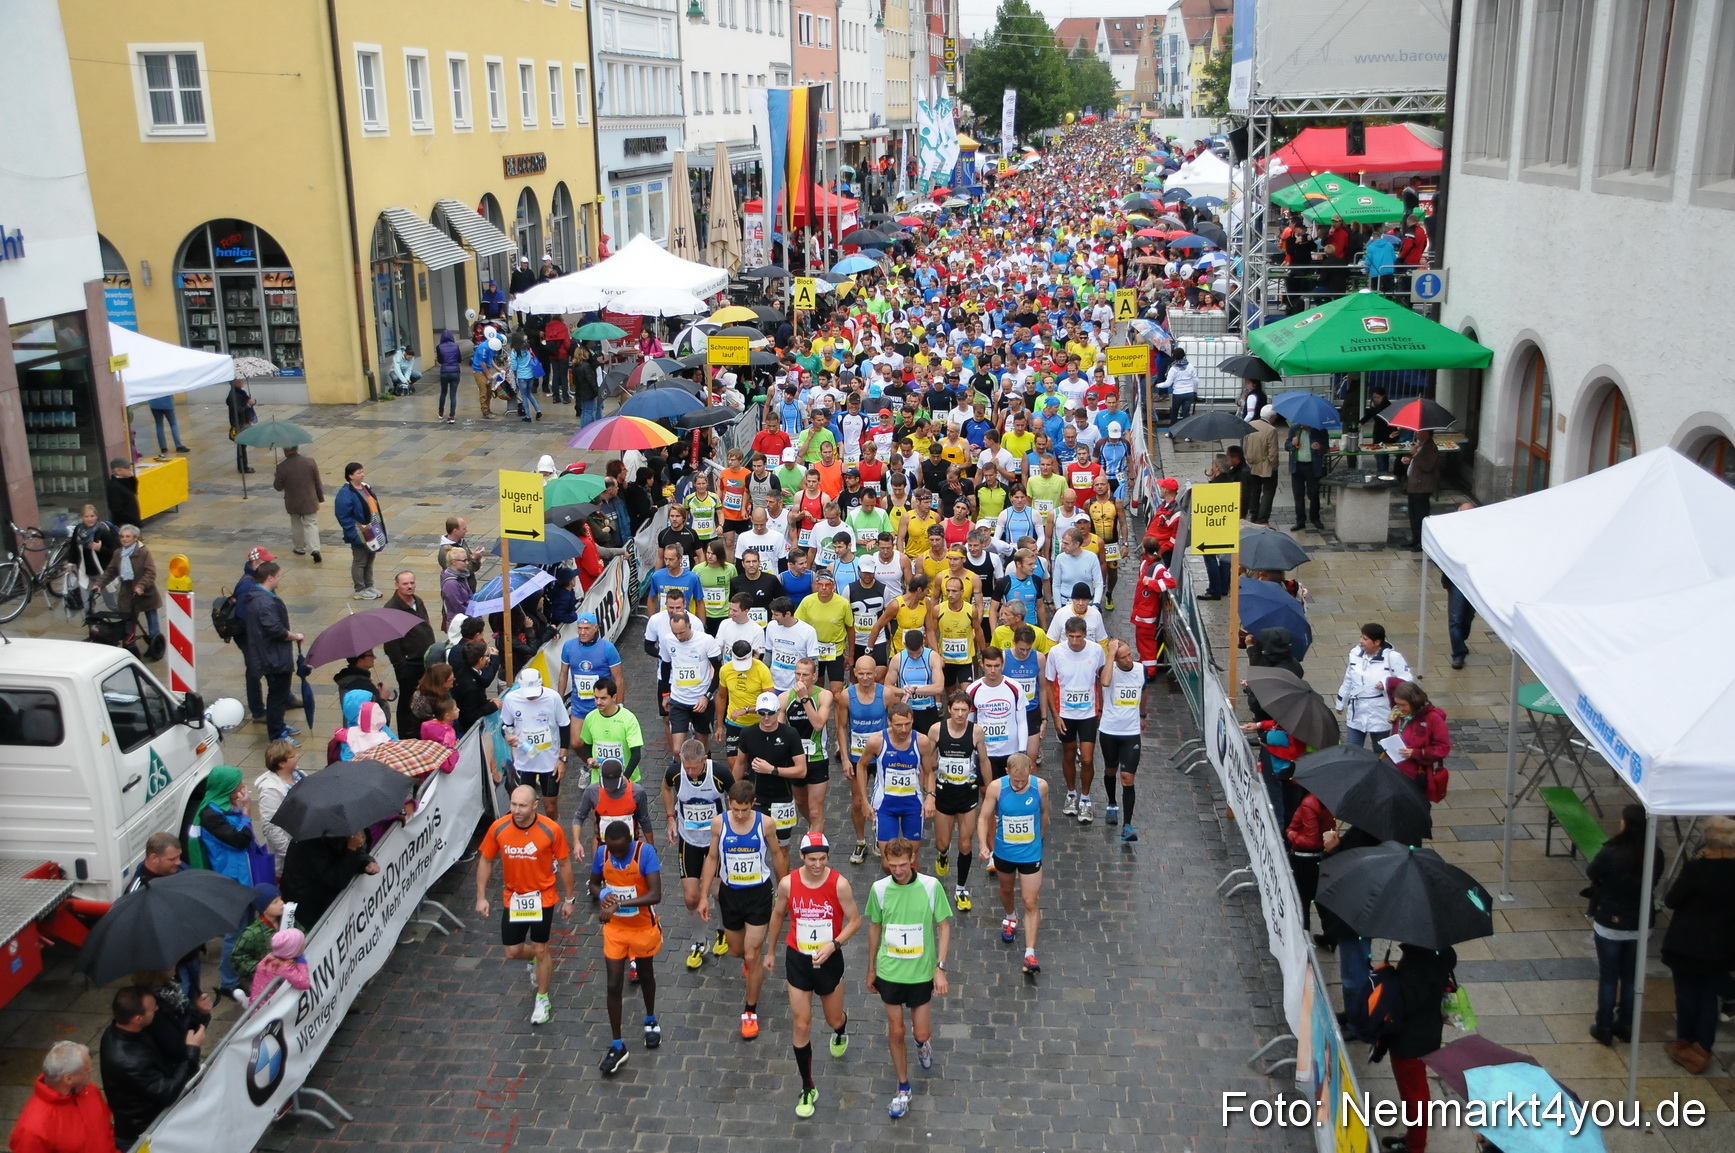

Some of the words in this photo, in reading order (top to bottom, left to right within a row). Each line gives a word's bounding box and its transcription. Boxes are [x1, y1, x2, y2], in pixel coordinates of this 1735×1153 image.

[799, 287, 810, 302] A
[1118, 299, 1133, 315] A
[1350, 336, 1413, 344] Neumarkter
[710, 344, 746, 353] Schnupper-
[1340, 342, 1426, 353] Lammsbräu
[1109, 354, 1146, 364] Schnupper-
[502, 489, 542, 502] Jugend-
[725, 496, 740, 505] 2618
[513, 502, 532, 514] lauf
[1194, 502, 1238, 515] Jugend-
[1205, 516, 1226, 527] lauf
[858, 618, 873, 626] 460
[945, 644, 965, 652] 2410
[775, 655, 796, 664] 2432
[679, 670, 696, 679] 578
[580, 681, 591, 690] 96
[1067, 693, 1089, 702] 2676
[1120, 689, 1137, 699] 506
[984, 726, 1006, 735] 2002
[527, 734, 545, 744] 587
[597, 747, 620, 758] 3016
[945, 764, 964, 774] 169
[891, 776, 911, 786] 543
[687, 810, 713, 822] 2132
[777, 807, 795, 820] 246
[1008, 823, 1029, 834] 555
[733, 861, 754, 873] 487
[516, 899, 535, 909] 199
[382, 892, 402, 928] Mehr
[810, 930, 817, 941] 4
[901, 933, 907, 945] 1
[295, 948, 336, 1028] BMW
